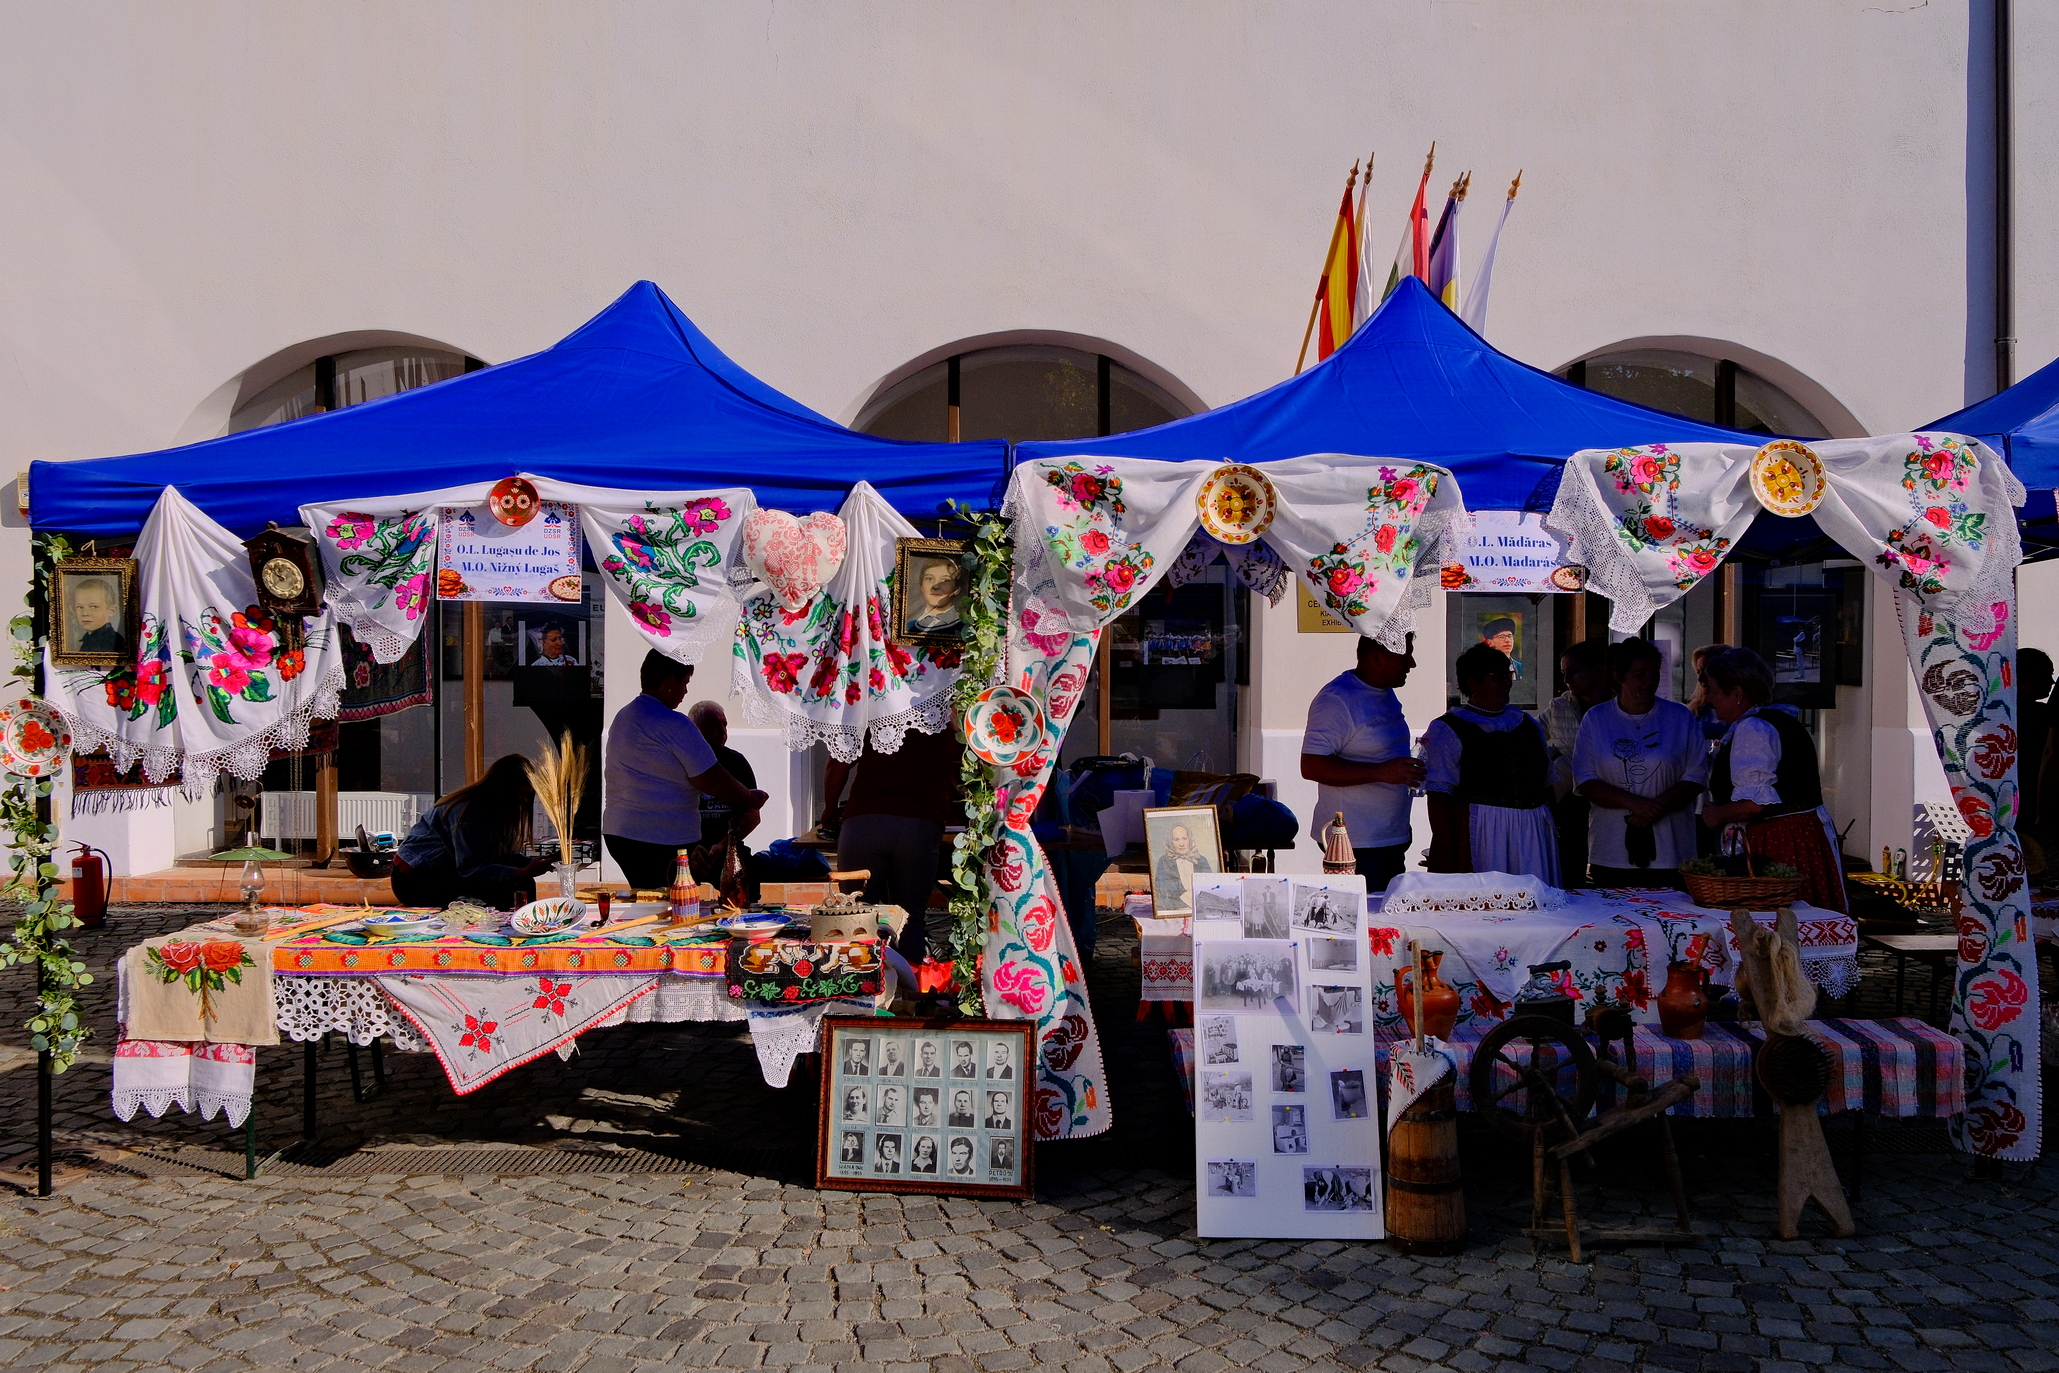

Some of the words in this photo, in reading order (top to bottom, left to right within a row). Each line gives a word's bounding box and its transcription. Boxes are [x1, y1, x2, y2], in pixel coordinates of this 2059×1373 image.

[1497, 536, 1552, 548] Mădăras
[456, 545, 479, 555] O.L.
[524, 546, 539, 556] de
[541, 546, 560, 556] Jos
[1469, 556, 1498, 567] M.O.
[1502, 556, 1556, 567] Madarás
[462, 562, 487, 572] M.O.
[489, 562, 521, 575] Nižný
[524, 563, 559, 576] Lugaš
